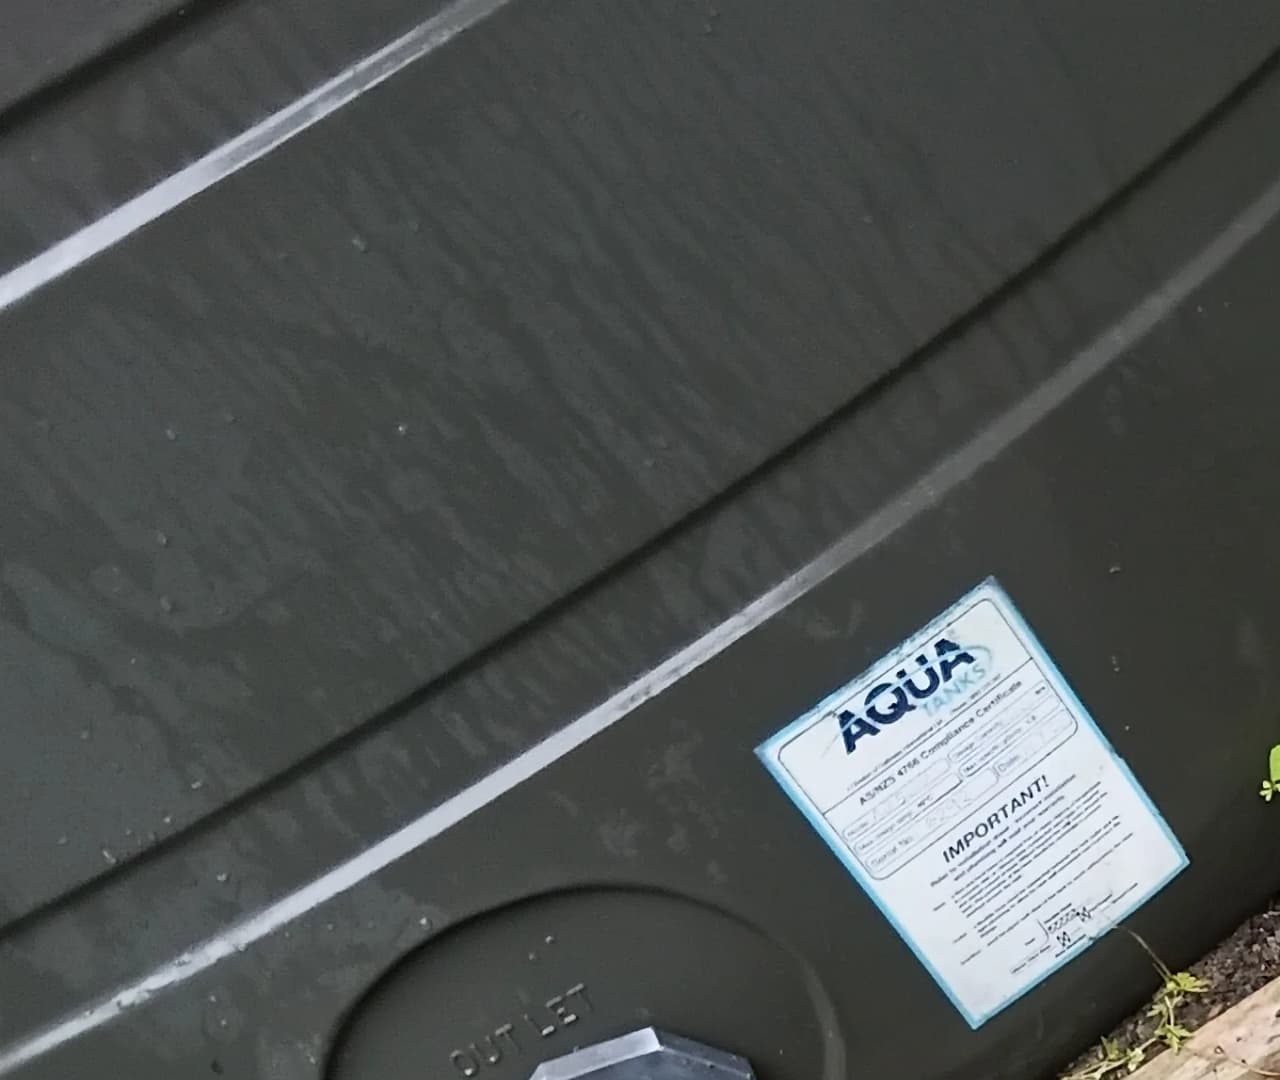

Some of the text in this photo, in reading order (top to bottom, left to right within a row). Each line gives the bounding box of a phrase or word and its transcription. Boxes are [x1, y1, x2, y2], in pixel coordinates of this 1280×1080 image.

[835, 638, 976, 755] AQUA
[920, 717, 975, 760] Compliance
[975, 681, 1022, 718] Certificate
[922, 664, 987, 718] TANKS
[943, 774, 1049, 863] IMPORTANT!
[449, 983, 595, 1077] OUTLET
